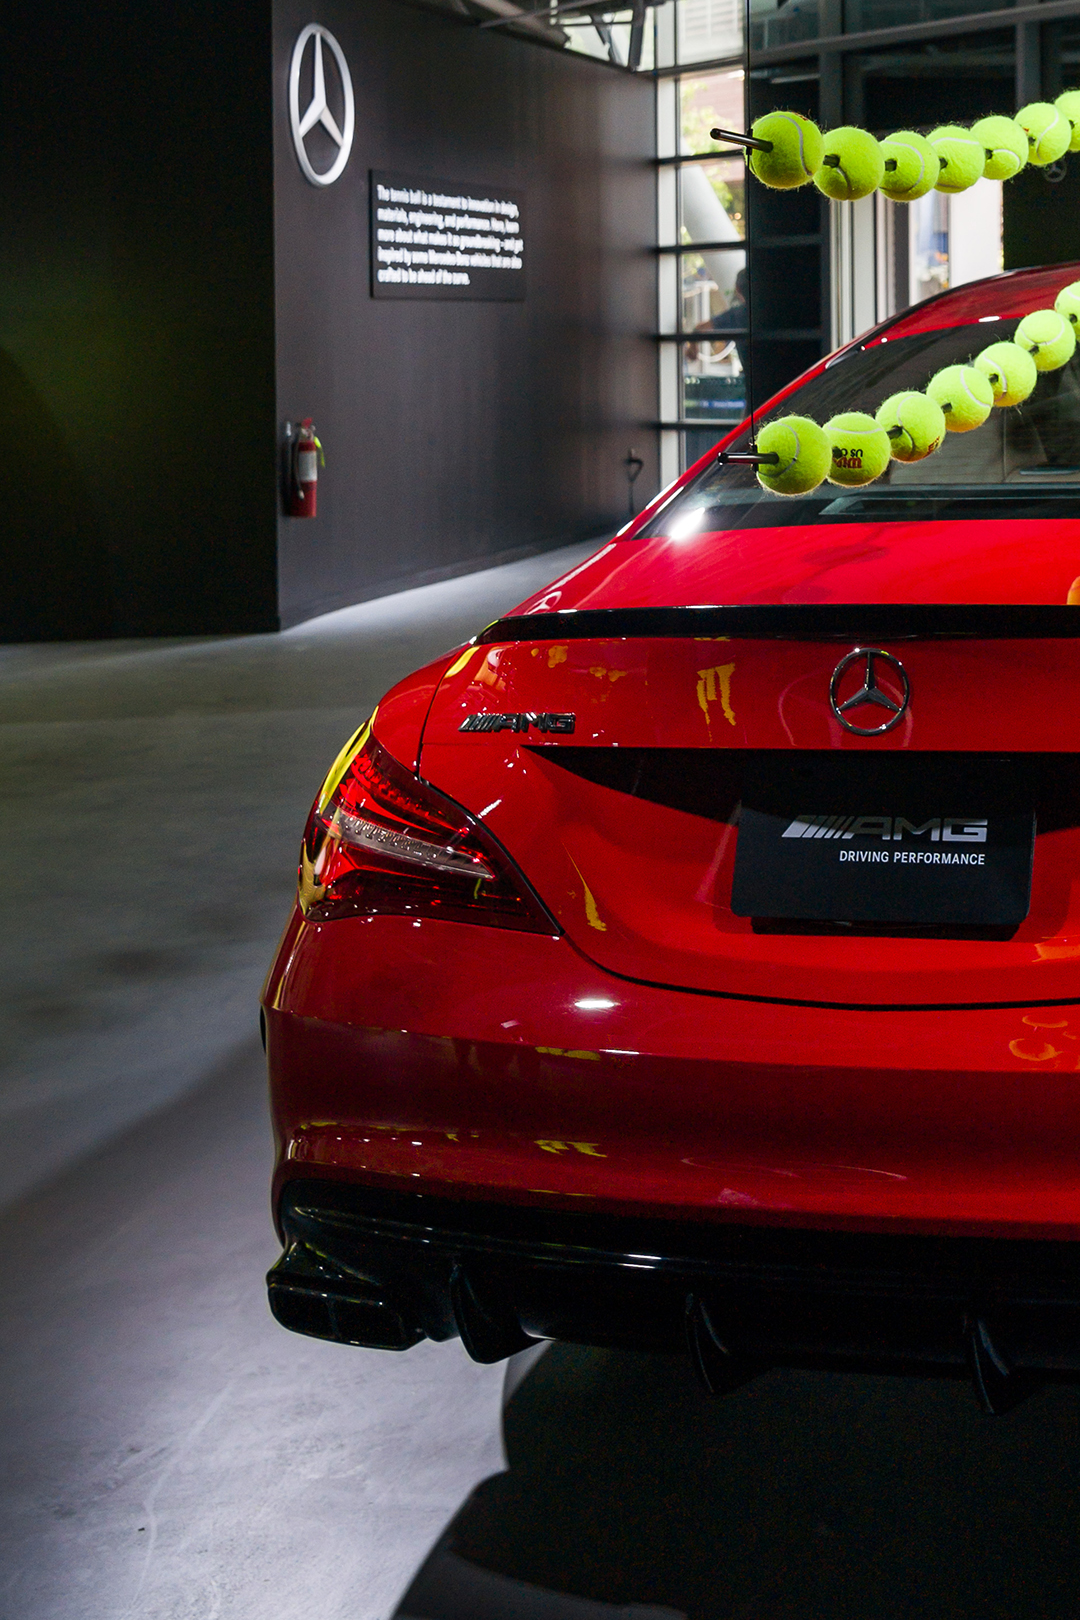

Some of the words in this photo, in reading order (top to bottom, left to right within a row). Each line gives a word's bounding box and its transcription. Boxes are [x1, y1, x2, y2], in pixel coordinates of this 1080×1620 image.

[850, 448, 864, 458] US
[839, 850, 890, 864] DRIVING
[893, 851, 986, 866] PERFORMANCE
